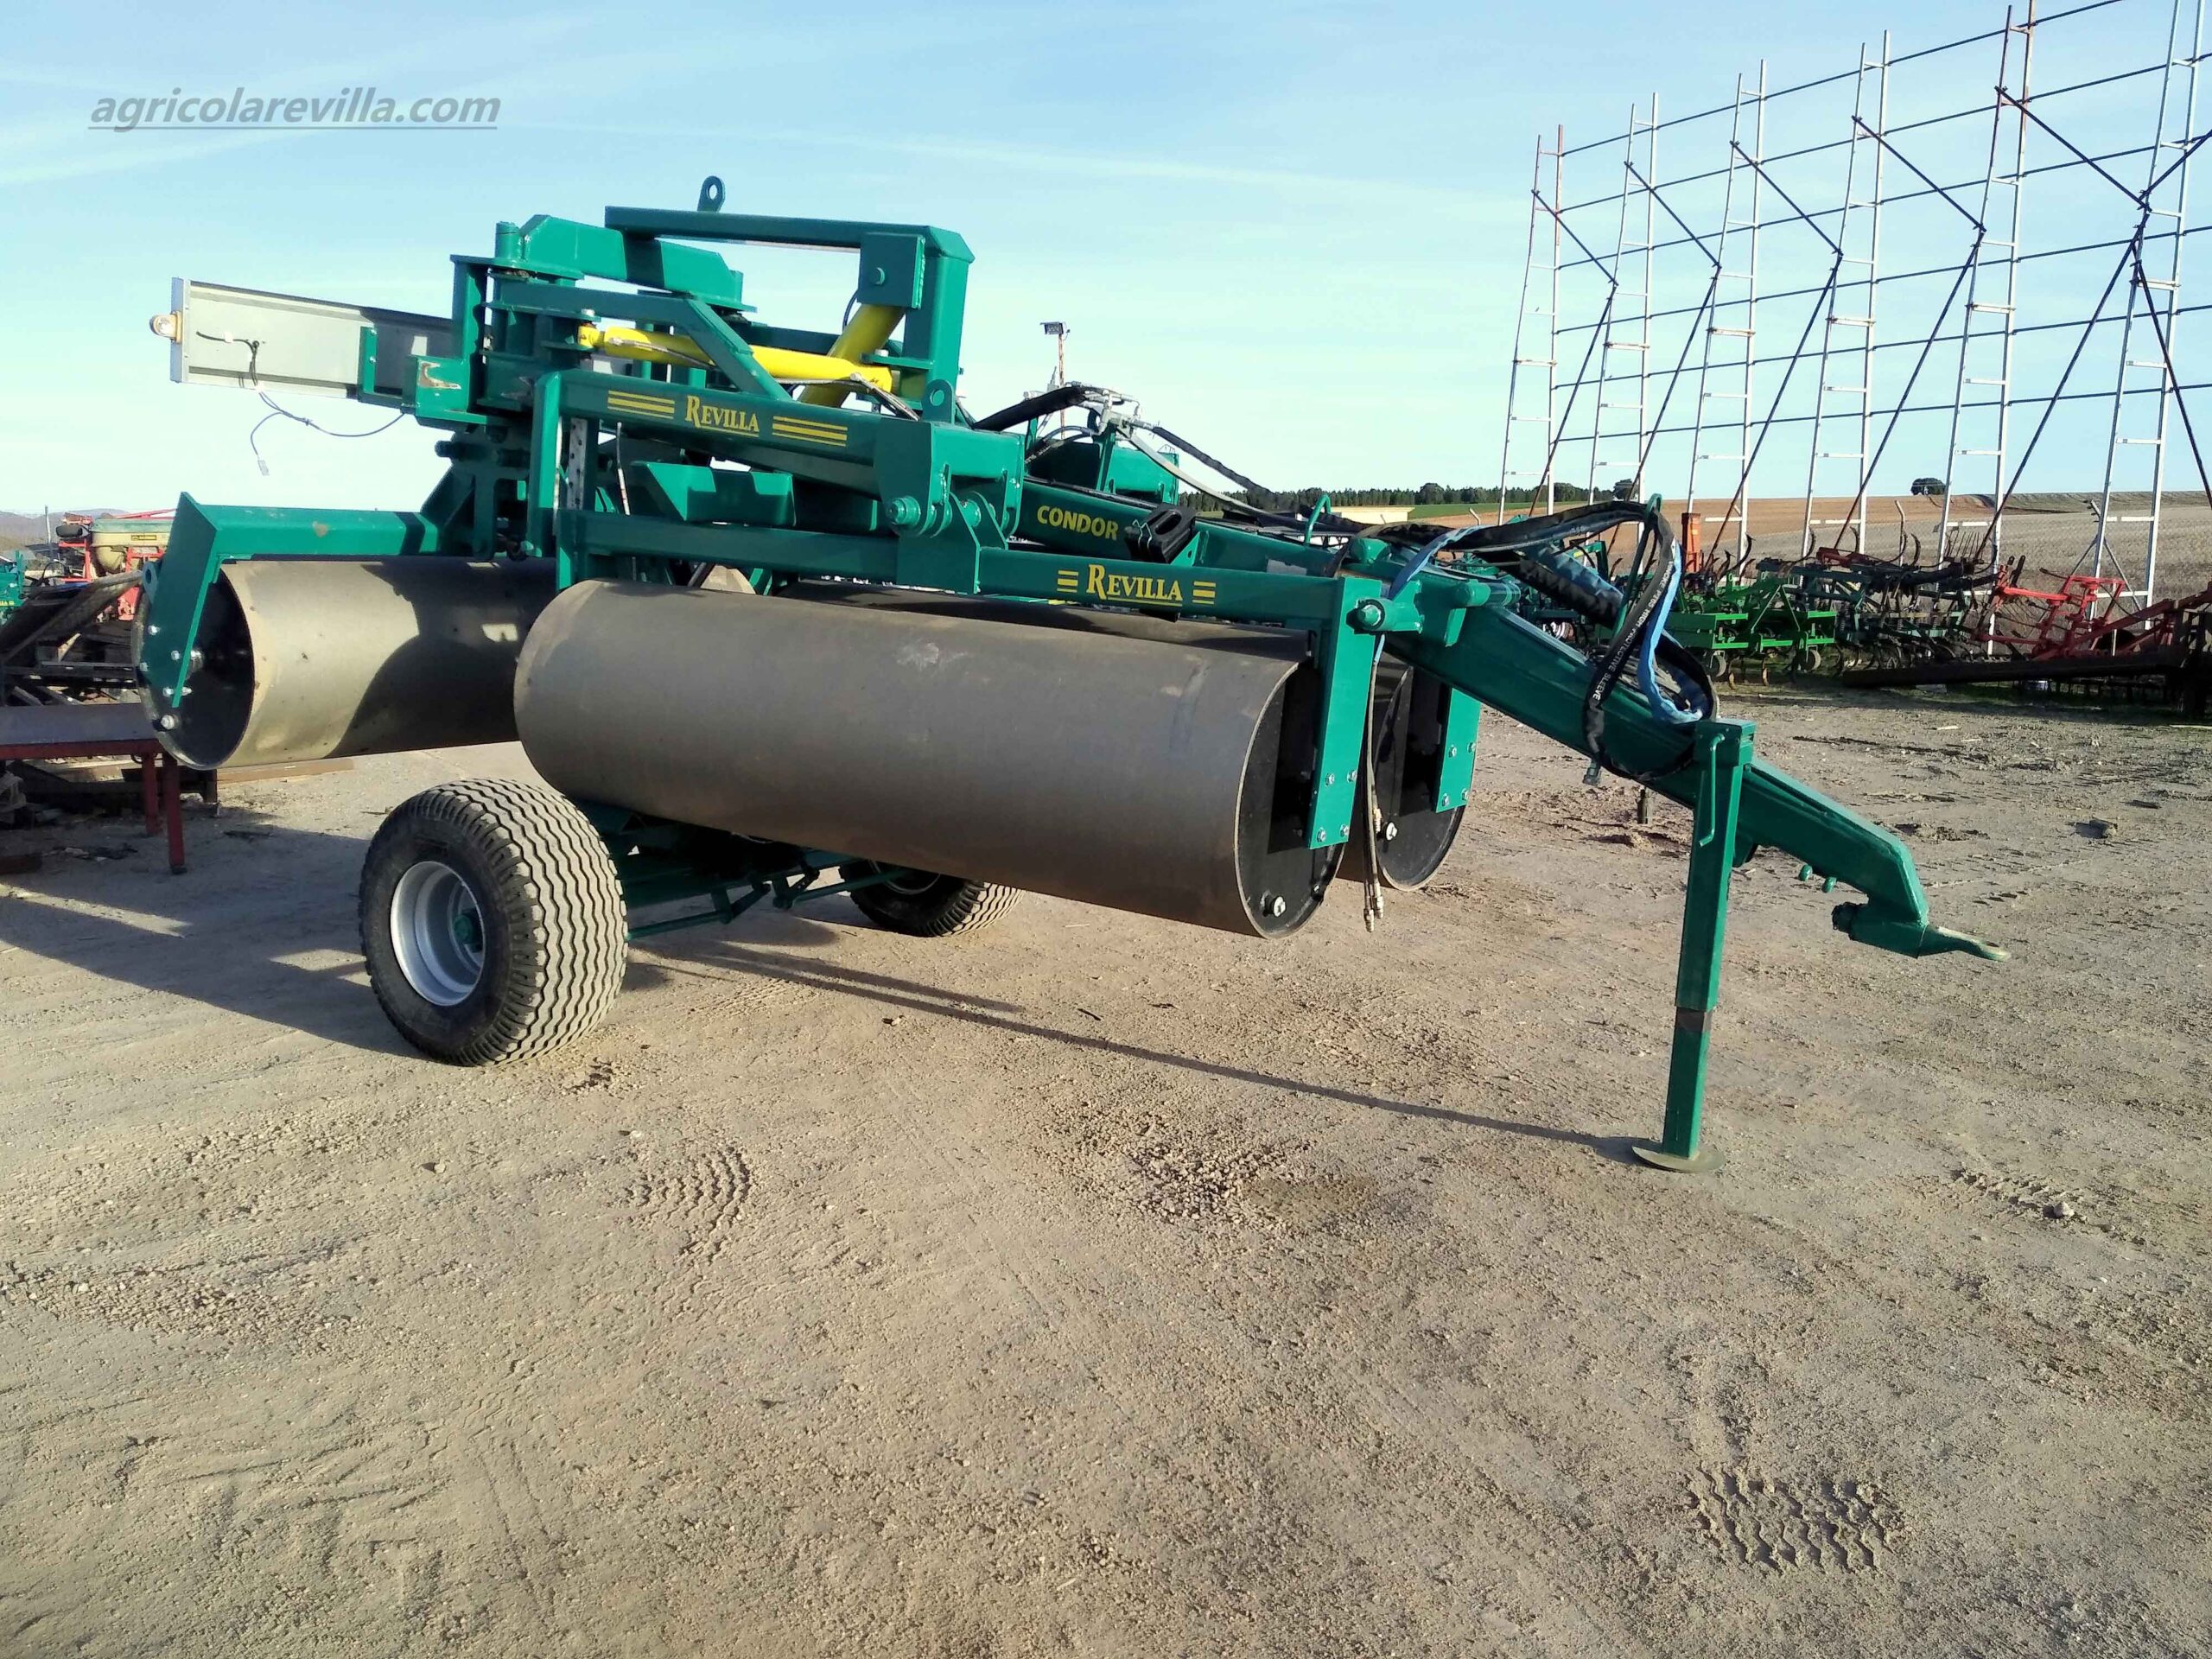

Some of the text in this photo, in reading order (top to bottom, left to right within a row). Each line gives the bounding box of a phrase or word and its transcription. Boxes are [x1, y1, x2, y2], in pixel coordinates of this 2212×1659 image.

[685, 395, 760, 434] REVILLA
[1037, 505, 1119, 541] CONDOR
[1086, 564, 1183, 602] REVILLA
[1635, 608, 1650, 628] HIGH
[1608, 627, 1639, 673] PROTECTIVE
[1592, 673, 1612, 701] SLEEVE
